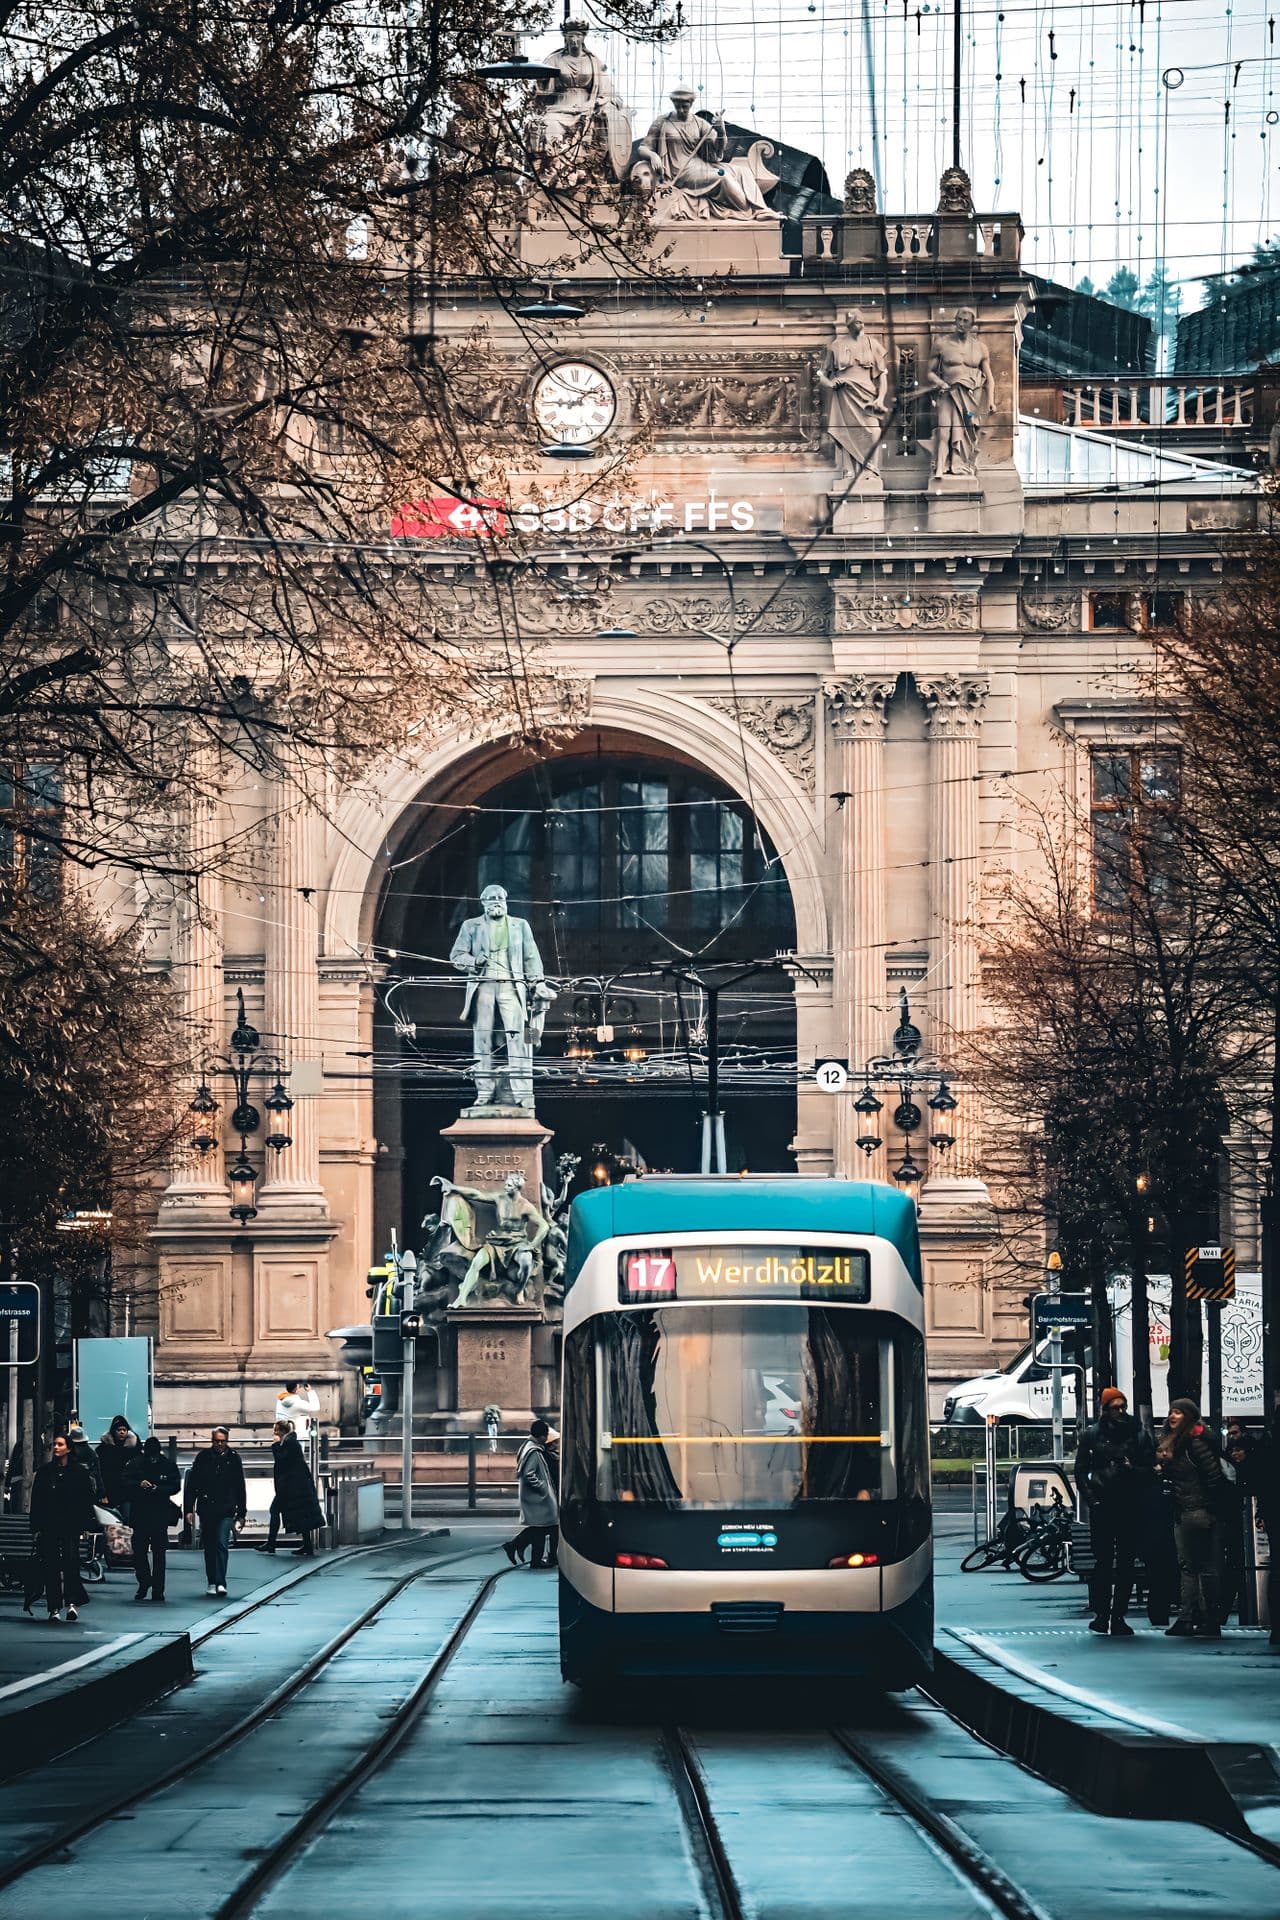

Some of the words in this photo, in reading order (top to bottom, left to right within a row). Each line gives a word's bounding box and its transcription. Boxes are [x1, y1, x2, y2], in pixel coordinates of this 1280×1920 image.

[517, 503, 593, 532] SBB
[684, 502, 754, 532] FFS
[823, 1070, 840, 1084] 12
[472, 1155, 521, 1165] ALFRED
[632, 1259, 671, 1287] 17
[696, 1257, 850, 1284] Werdhölzli
[1234, 1298, 1262, 1309] TARIA
[1149, 1326, 1163, 1334] 25
[1220, 1383, 1263, 1395] STAURA
